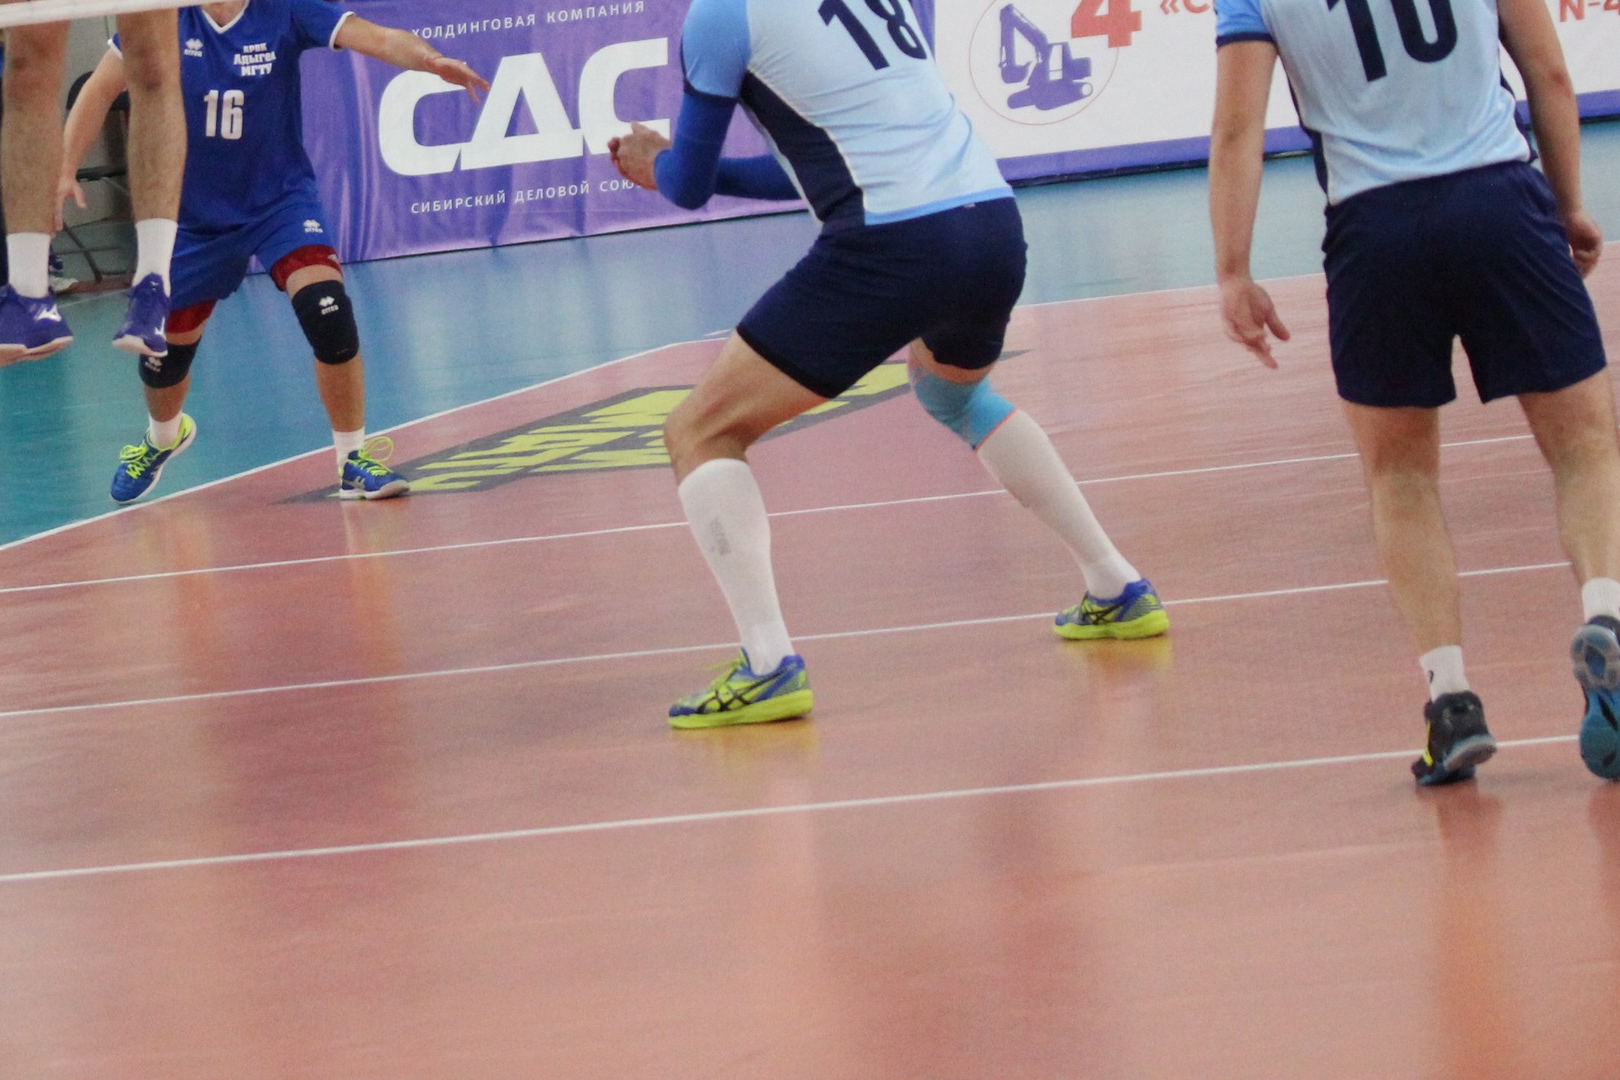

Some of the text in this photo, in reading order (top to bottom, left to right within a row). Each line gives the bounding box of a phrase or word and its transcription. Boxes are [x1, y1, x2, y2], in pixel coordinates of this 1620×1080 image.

[411, 0, 646, 39] ХОЛДИНГОВАЯ КОМПАНИЯ
[203, 89, 245, 140] 16
[411, 174, 640, 214] СИБИРСКИЙ ДЕЛОВОЙ СОЮ
